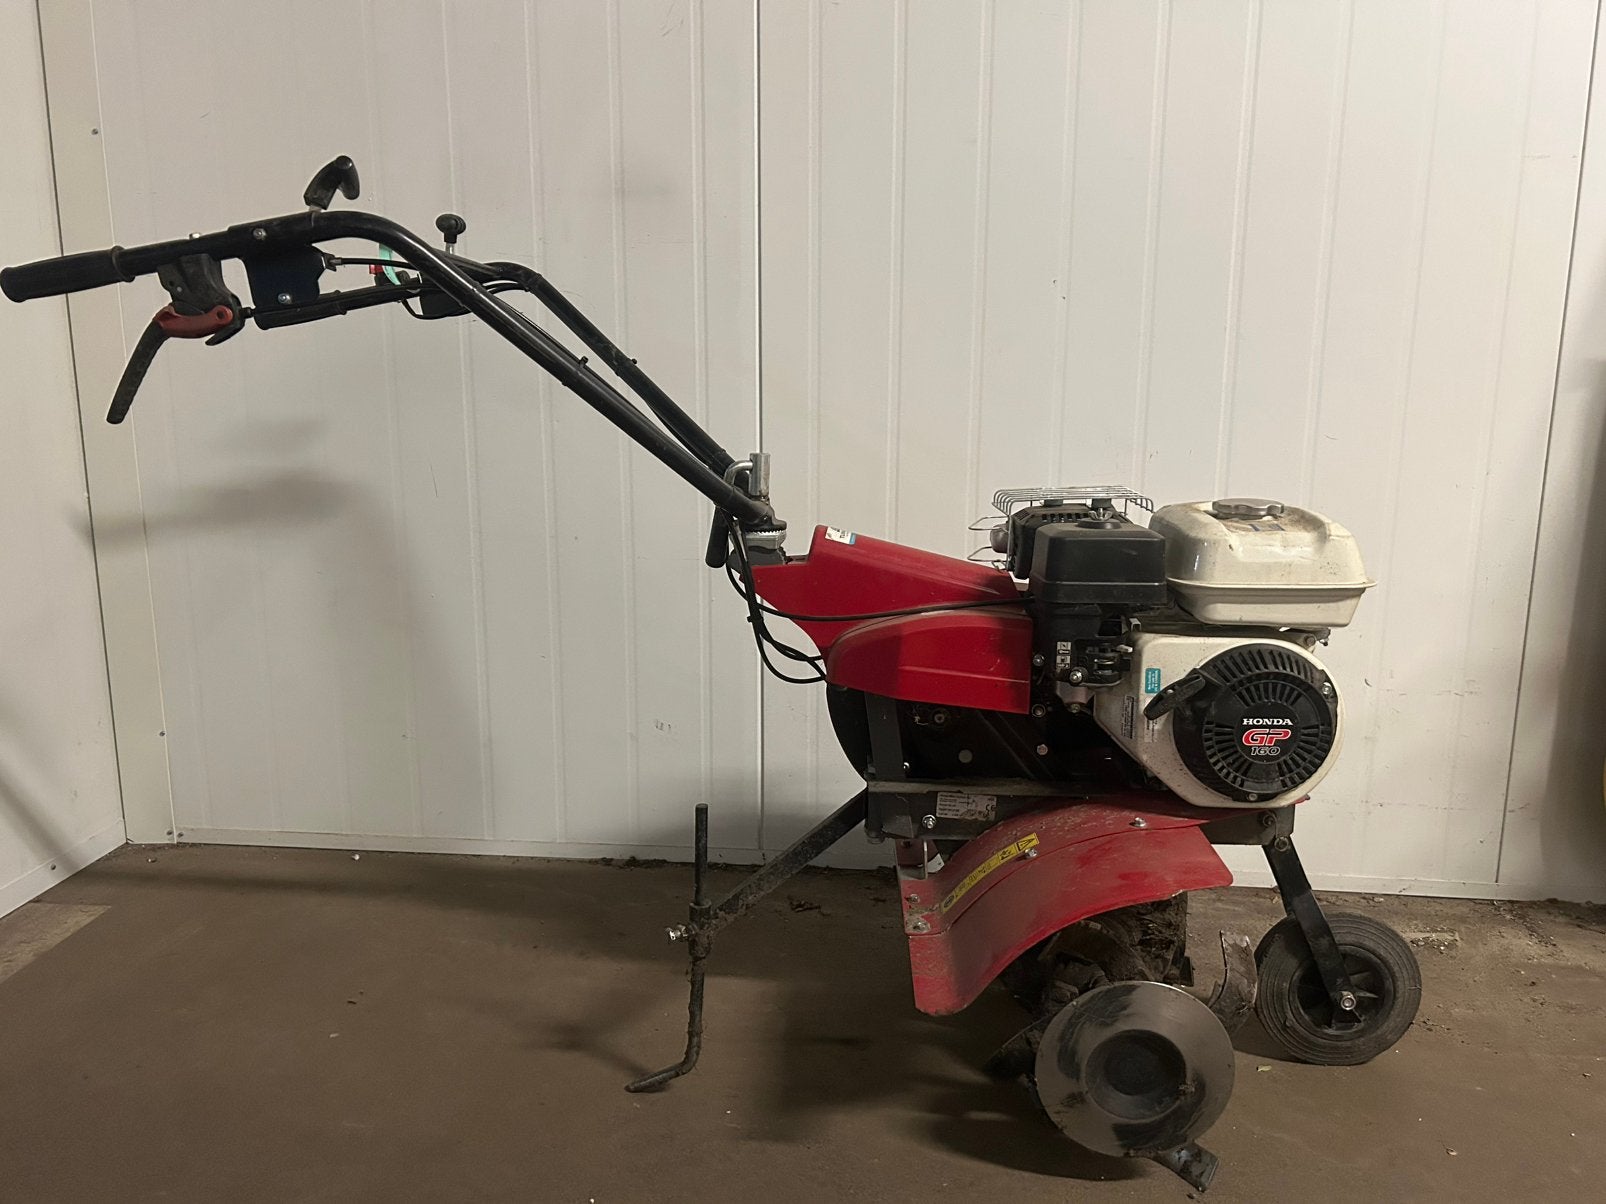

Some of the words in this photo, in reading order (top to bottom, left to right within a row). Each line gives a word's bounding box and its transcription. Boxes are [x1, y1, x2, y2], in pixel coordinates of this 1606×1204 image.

[1242, 718, 1293, 726] HONDA
[1242, 728, 1292, 746] GP
[1250, 746, 1281, 756] 160
